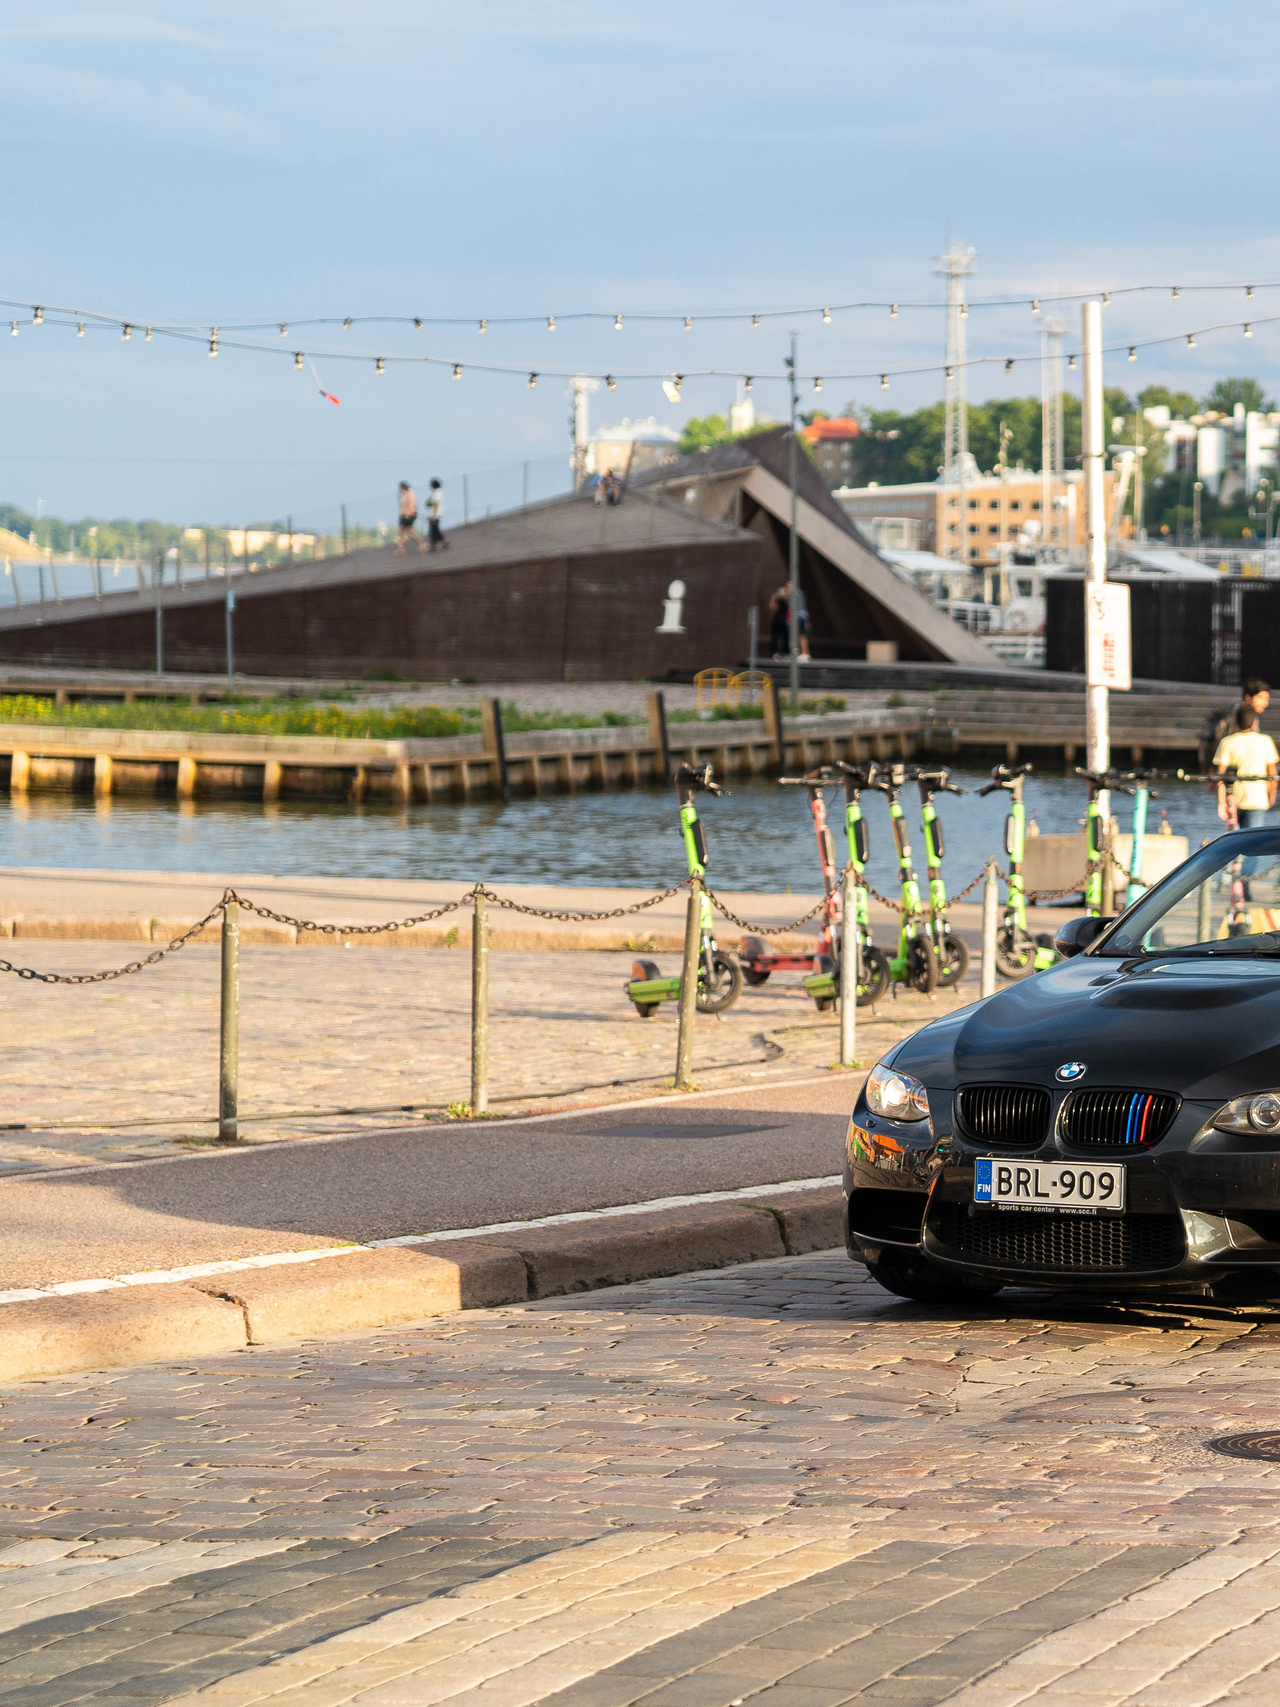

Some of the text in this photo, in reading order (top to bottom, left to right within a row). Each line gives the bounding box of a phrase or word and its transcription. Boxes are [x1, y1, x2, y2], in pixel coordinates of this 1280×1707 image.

[977, 1183, 991, 1193] FIN
[997, 1166, 1115, 1201] BRL-909
[998, 1204, 1019, 1212] sports
